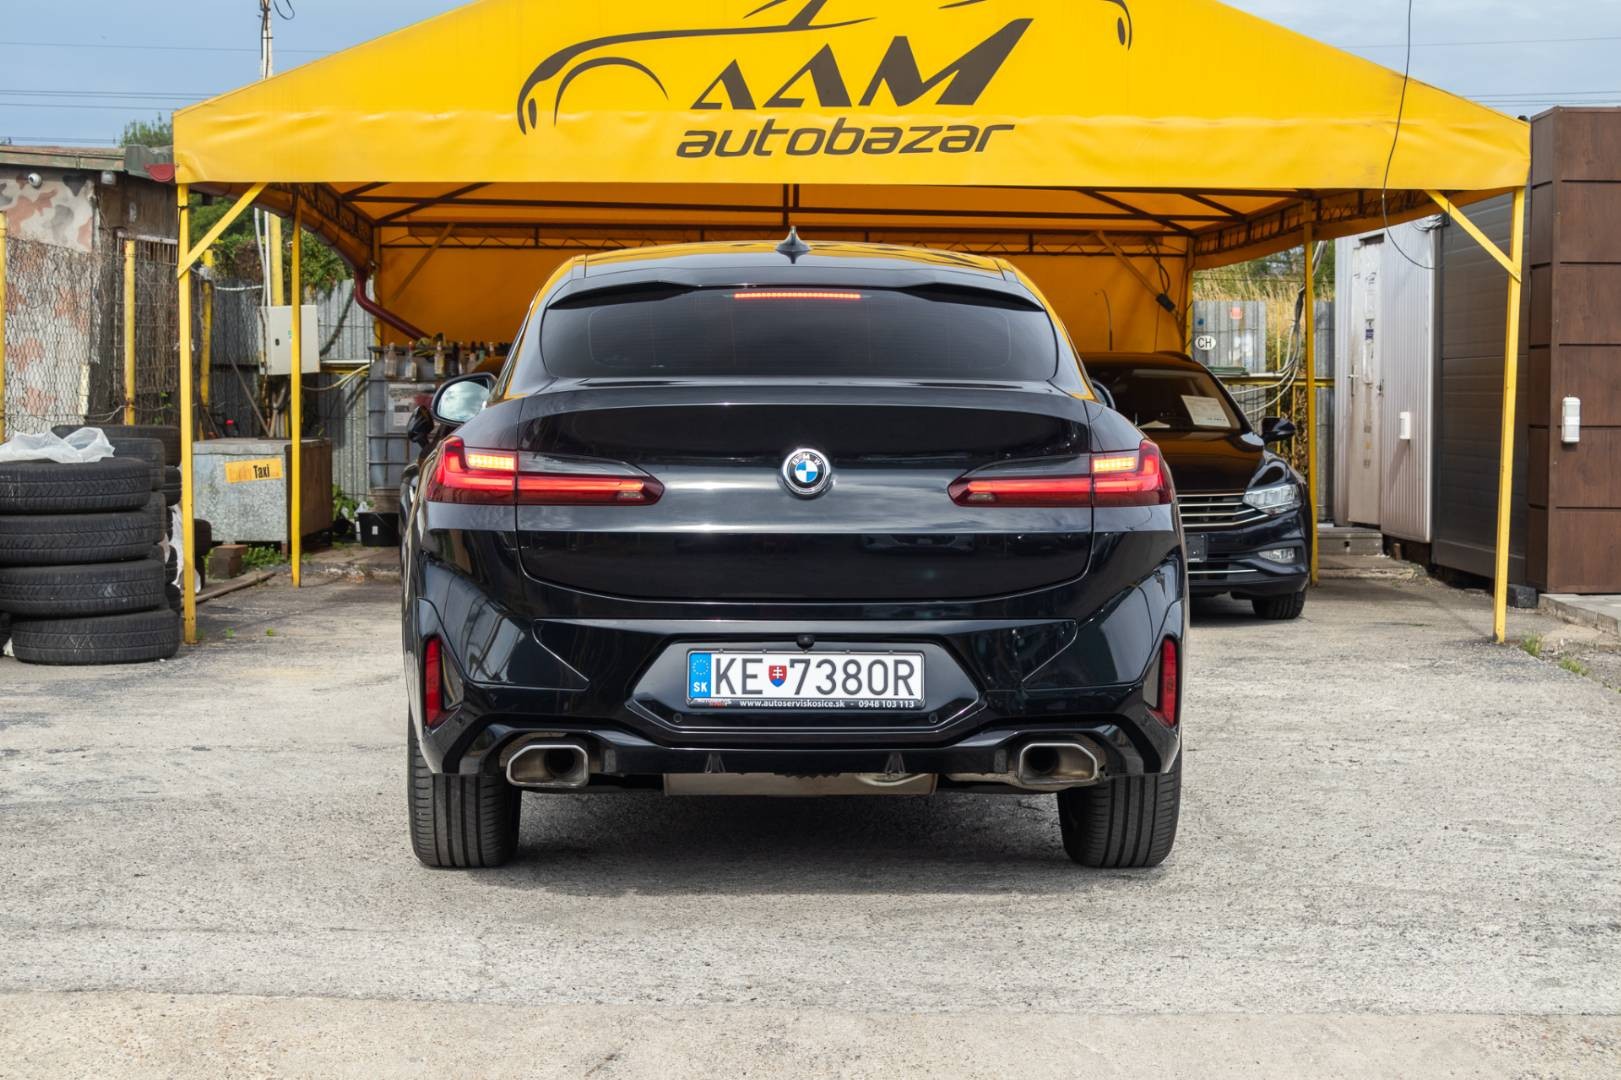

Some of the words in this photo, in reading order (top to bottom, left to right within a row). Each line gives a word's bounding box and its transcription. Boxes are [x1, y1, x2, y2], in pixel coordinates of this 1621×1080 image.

[690, 18, 1034, 110] AAM
[676, 117, 1015, 158] autobazar
[1197, 337, 1212, 349] CH
[253, 463, 270, 479] Taxi
[715, 658, 763, 695] KE
[693, 681, 708, 692] SK
[739, 700, 845, 708] www.autoserviskosice.sk
[882, 700, 897, 708] 103
[900, 700, 914, 708] 113
